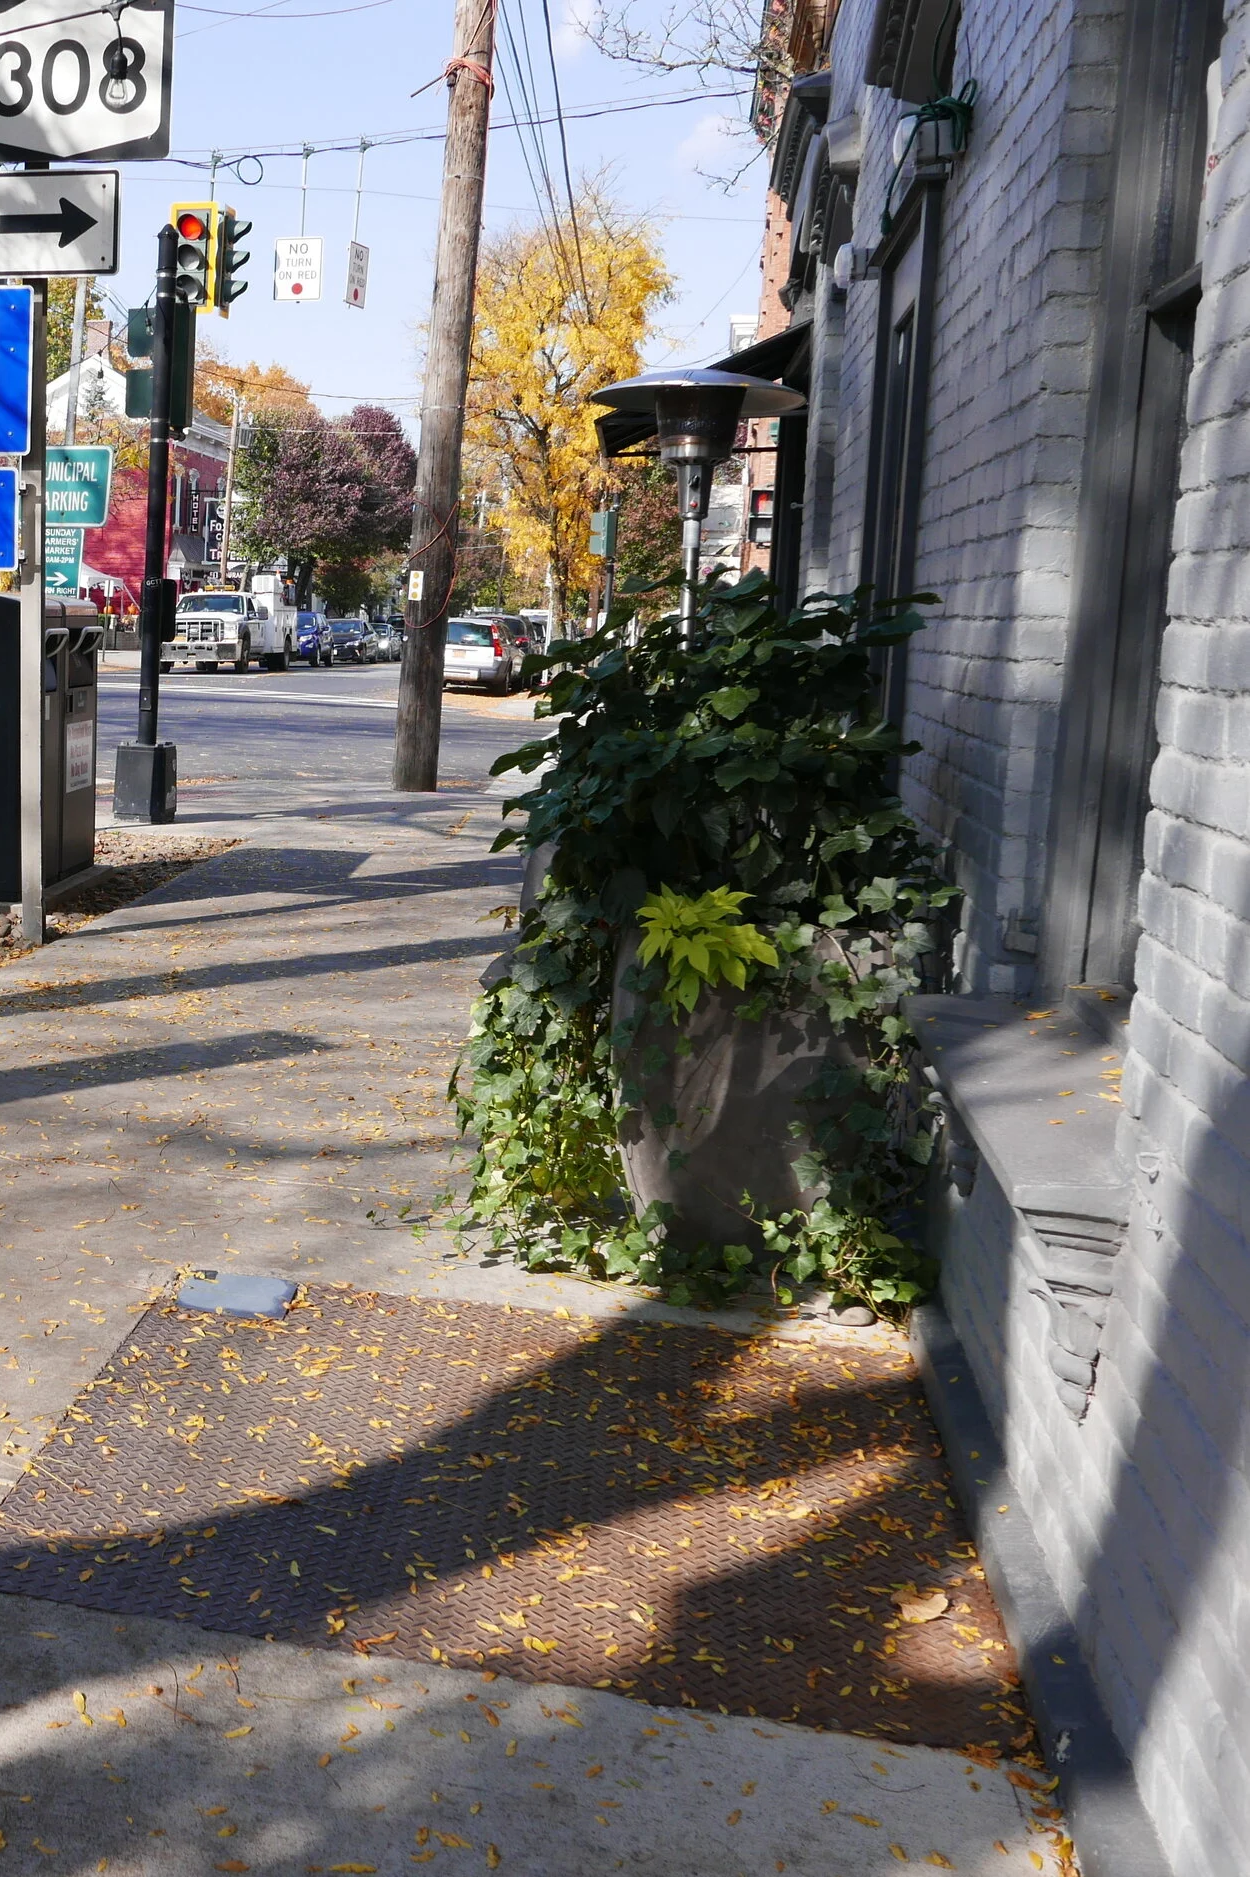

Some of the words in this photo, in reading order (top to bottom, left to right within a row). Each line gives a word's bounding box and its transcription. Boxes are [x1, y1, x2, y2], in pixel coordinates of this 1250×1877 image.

[289, 243, 309, 255] NO
[286, 258, 312, 267] TURN
[278, 271, 292, 281] ON
[297, 270, 317, 280] RED
[46, 461, 97, 482] UNICIPAL
[45, 490, 89, 512] ARKING
[192, 494, 200, 532] HOTEL
[45, 528, 76, 537] SUNDAY
[45, 537, 79, 546] ARMERS'
[46, 556, 75, 564] 0AM-2PM
[45, 586, 55, 595] RN
[56, 587, 77, 596] RIGHT
